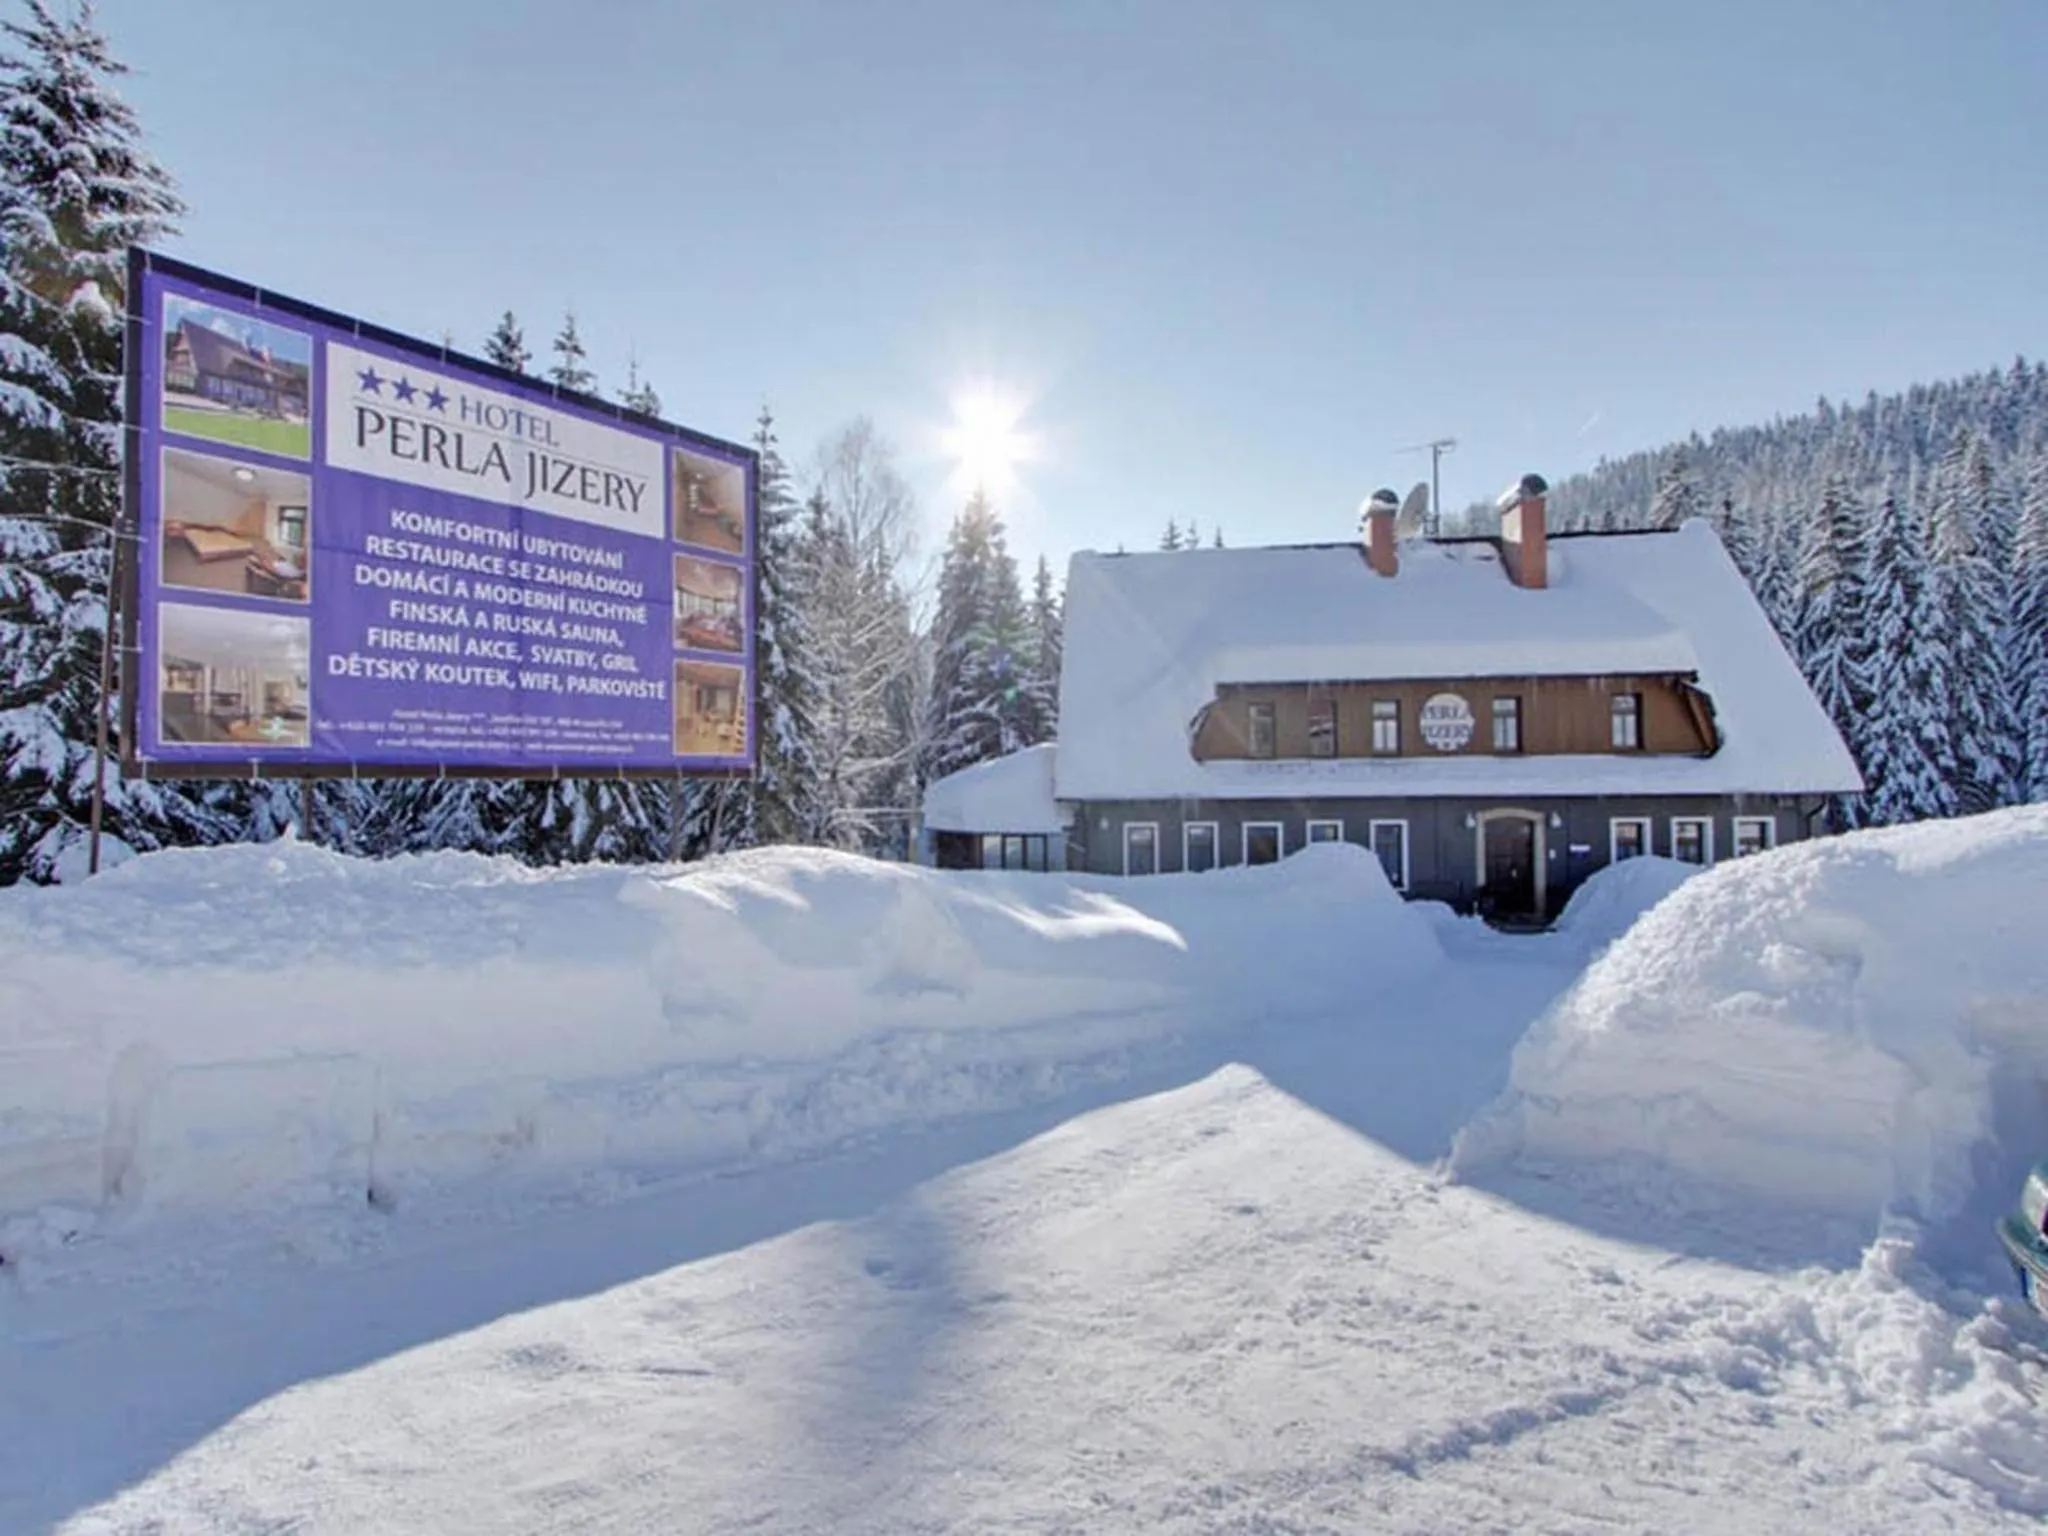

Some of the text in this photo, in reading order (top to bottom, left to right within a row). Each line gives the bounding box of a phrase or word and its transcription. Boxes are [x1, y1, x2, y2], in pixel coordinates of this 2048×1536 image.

[460, 395, 560, 447] HOTEL
[355, 406, 646, 513] PERLA JIZERY
[391, 510, 519, 550] KOMFORTNÍ
[355, 563, 449, 595] DOMÁCÍ
[453, 579, 469, 599] A
[366, 536, 643, 598] RESTAURACE SE ZAHRÁDKOU
[390, 600, 470, 627] FINSKÁ
[474, 610, 489, 629] A
[367, 626, 460, 654] FIREMNÍ
[328, 653, 421, 681] DĚTSKÝ
